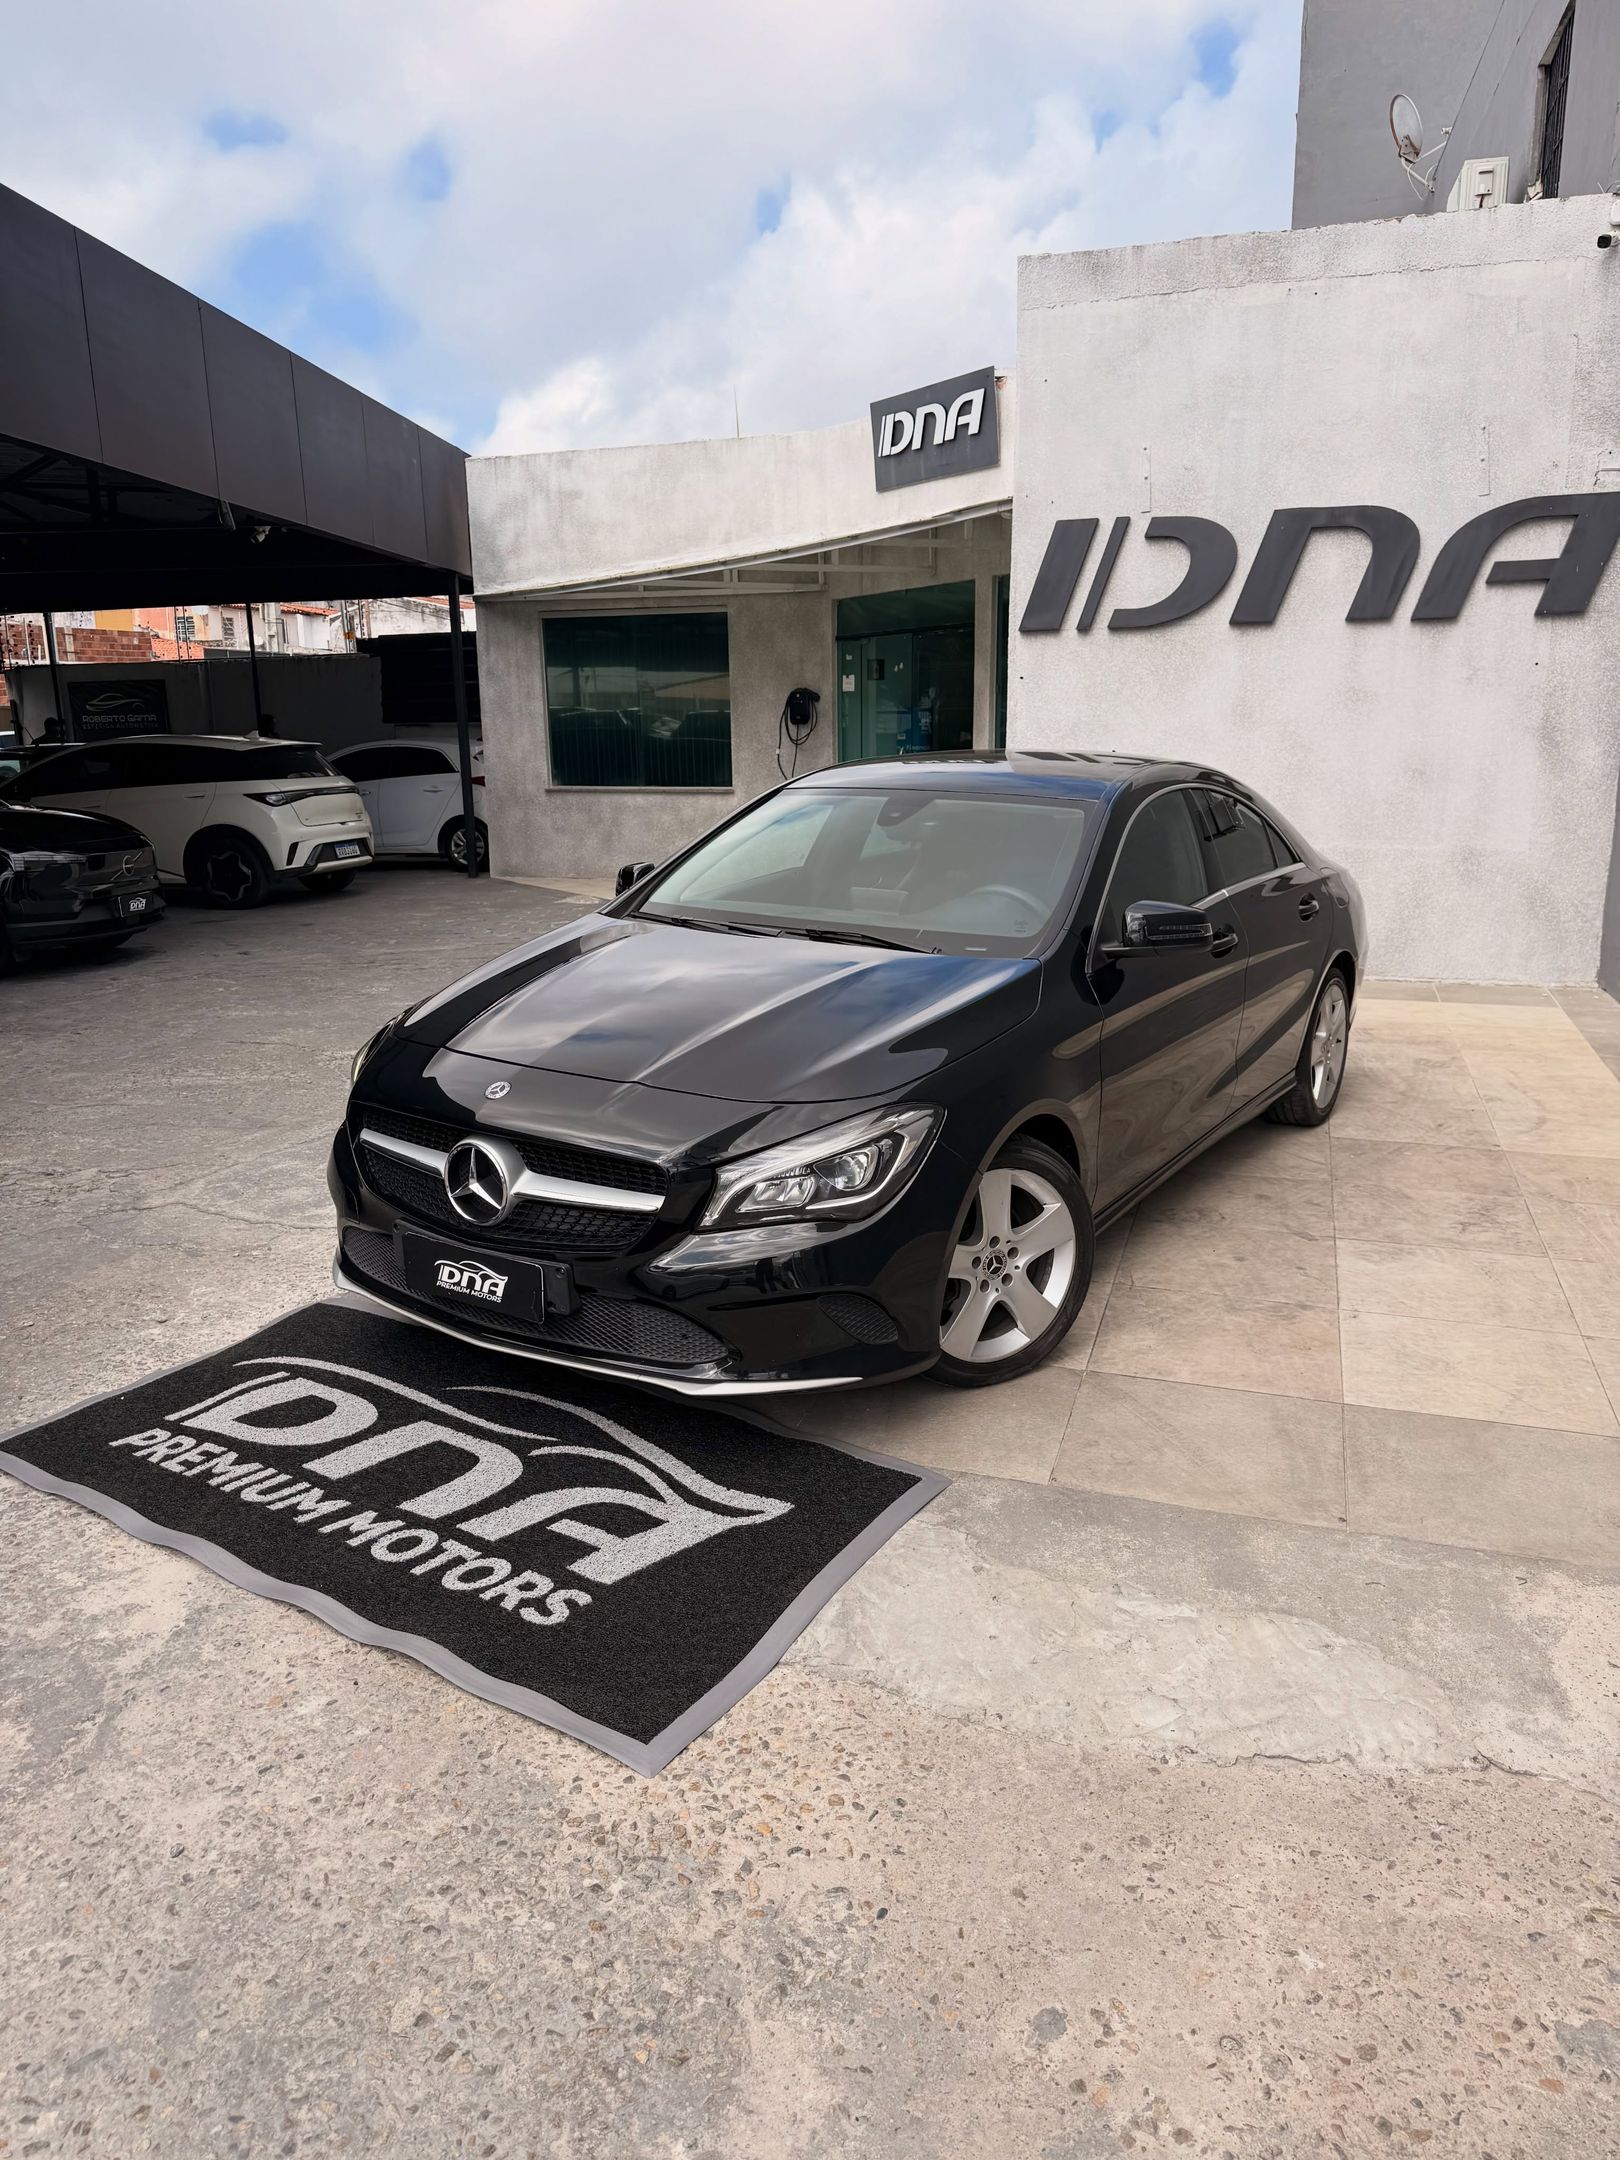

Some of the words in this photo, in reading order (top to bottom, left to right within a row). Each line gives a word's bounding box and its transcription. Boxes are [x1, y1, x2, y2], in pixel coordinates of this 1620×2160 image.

[82, 714, 126, 723] ROBERTO
[127, 714, 156, 722] GAMA
[436, 1280, 470, 1295] PREMIUM
[470, 1289, 502, 1303] MOTORS
[109, 1427, 350, 1523] PREMIUM
[318, 1510, 593, 1626] MOTORS
